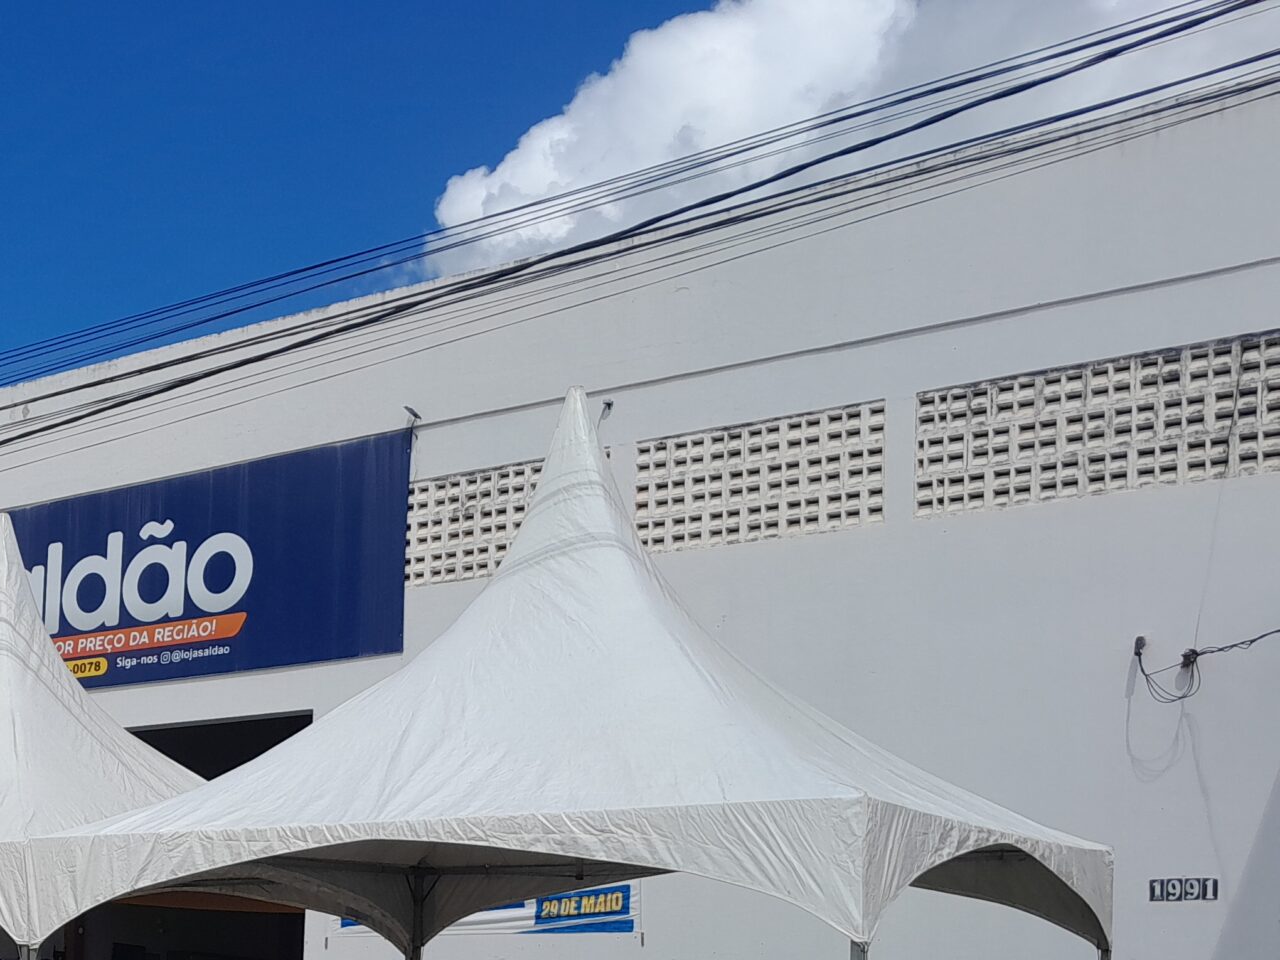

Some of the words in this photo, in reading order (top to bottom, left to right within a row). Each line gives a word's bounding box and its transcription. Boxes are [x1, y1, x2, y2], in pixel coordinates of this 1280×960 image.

[77, 633, 125, 653] PREÇO
[129, 631, 149, 647] DA
[154, 619, 217, 643] REGIÃO!
[116, 654, 158, 669] Siga-nos
[171, 645, 230, 663] @lojasaldao
[1150, 878, 1217, 901] 1991
[540, 901, 559, 918] 29
[560, 897, 580, 916] DE
[581, 891, 623, 914] MAIO
